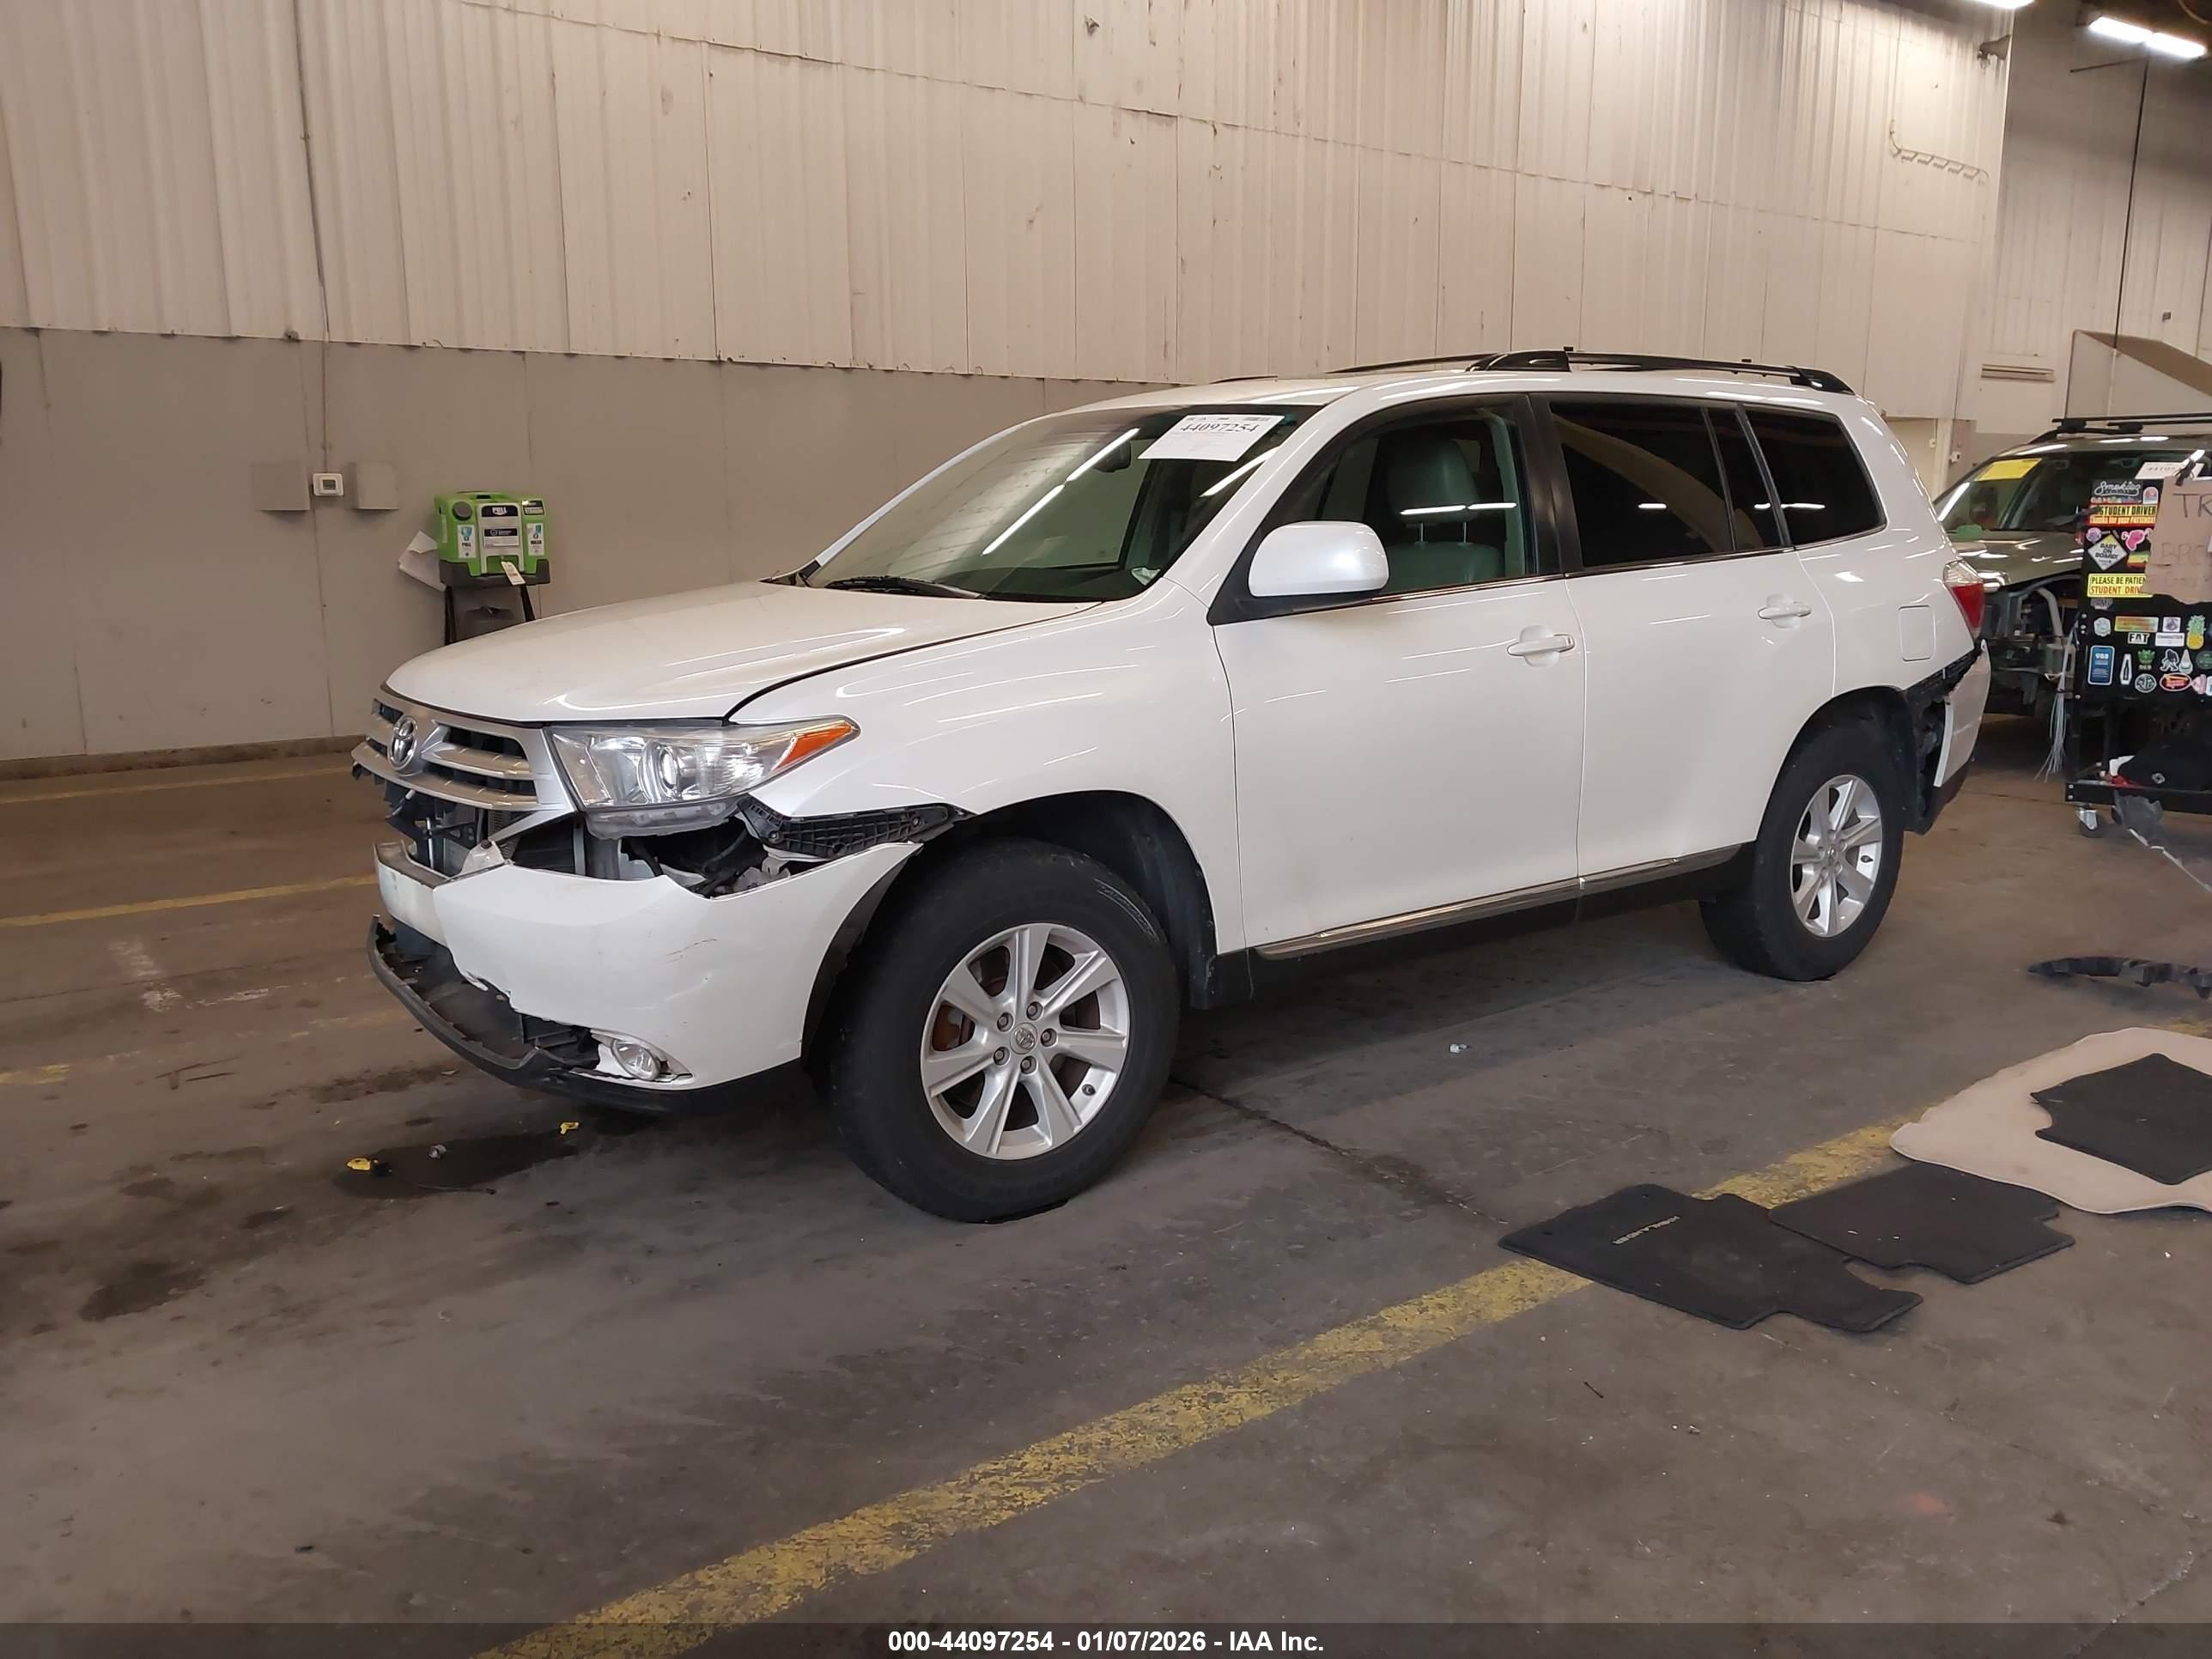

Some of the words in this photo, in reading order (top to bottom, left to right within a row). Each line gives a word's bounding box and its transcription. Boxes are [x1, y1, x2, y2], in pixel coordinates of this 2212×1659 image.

[1180, 423, 1260, 432] 44097254
[2100, 506, 2130, 515] STUDENT
[2131, 506, 2156, 515] DRIVER
[2091, 576, 2114, 585] PLEASE
[2116, 576, 2123, 585] BE
[2124, 576, 2146, 585] PATIEN
[2091, 586, 2121, 594] STUDENT
[2124, 586, 2142, 594] DRIV
[2129, 633, 2148, 642] FAT
